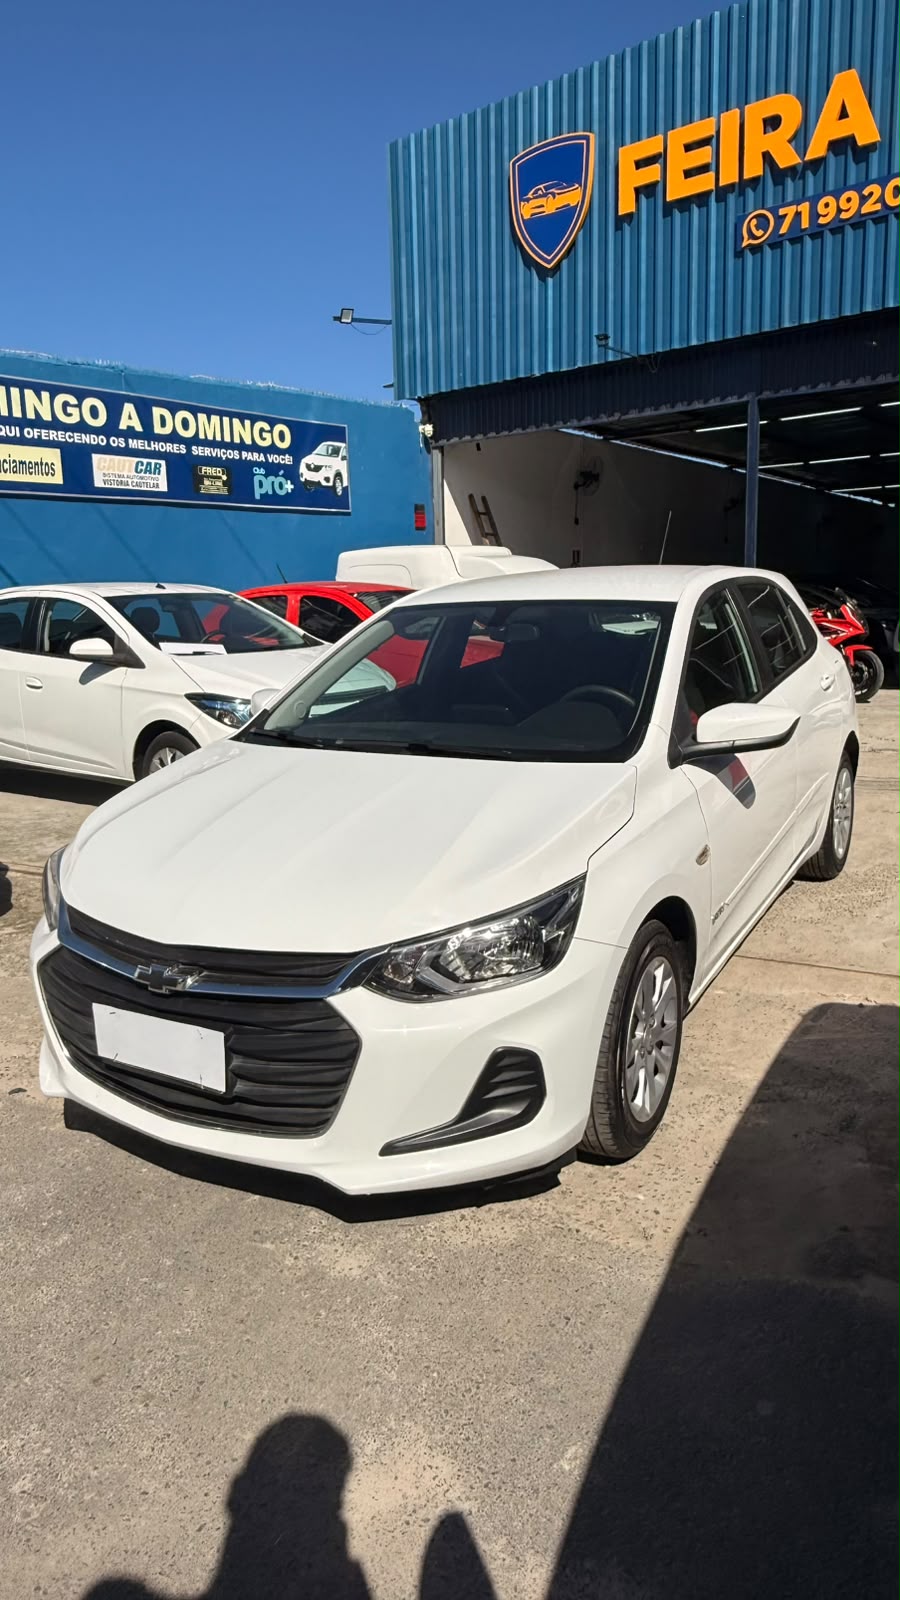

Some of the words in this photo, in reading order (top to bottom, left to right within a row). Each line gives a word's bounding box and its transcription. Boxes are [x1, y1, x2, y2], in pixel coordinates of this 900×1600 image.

[618, 68, 881, 216] FEIRA
[778, 201, 810, 235] 71
[817, 177, 900, 225] 9920
[118, 402, 144, 432] A
[152, 406, 292, 449] DOMINGO
[0, 453, 56, 477] ciamentos
[24, 427, 106, 446] OFERECENDO
[109, 437, 126, 447] OS
[128, 438, 187, 454] MELHORES
[192, 446, 239, 460] SERVIÇOS
[242, 451, 265, 462] PARA
[267, 453, 293, 465] VOCÊ!
[103, 479, 130, 487] VISTORIA
[131, 481, 160, 489] CAUTELAR
[201, 467, 223, 476] FRED
